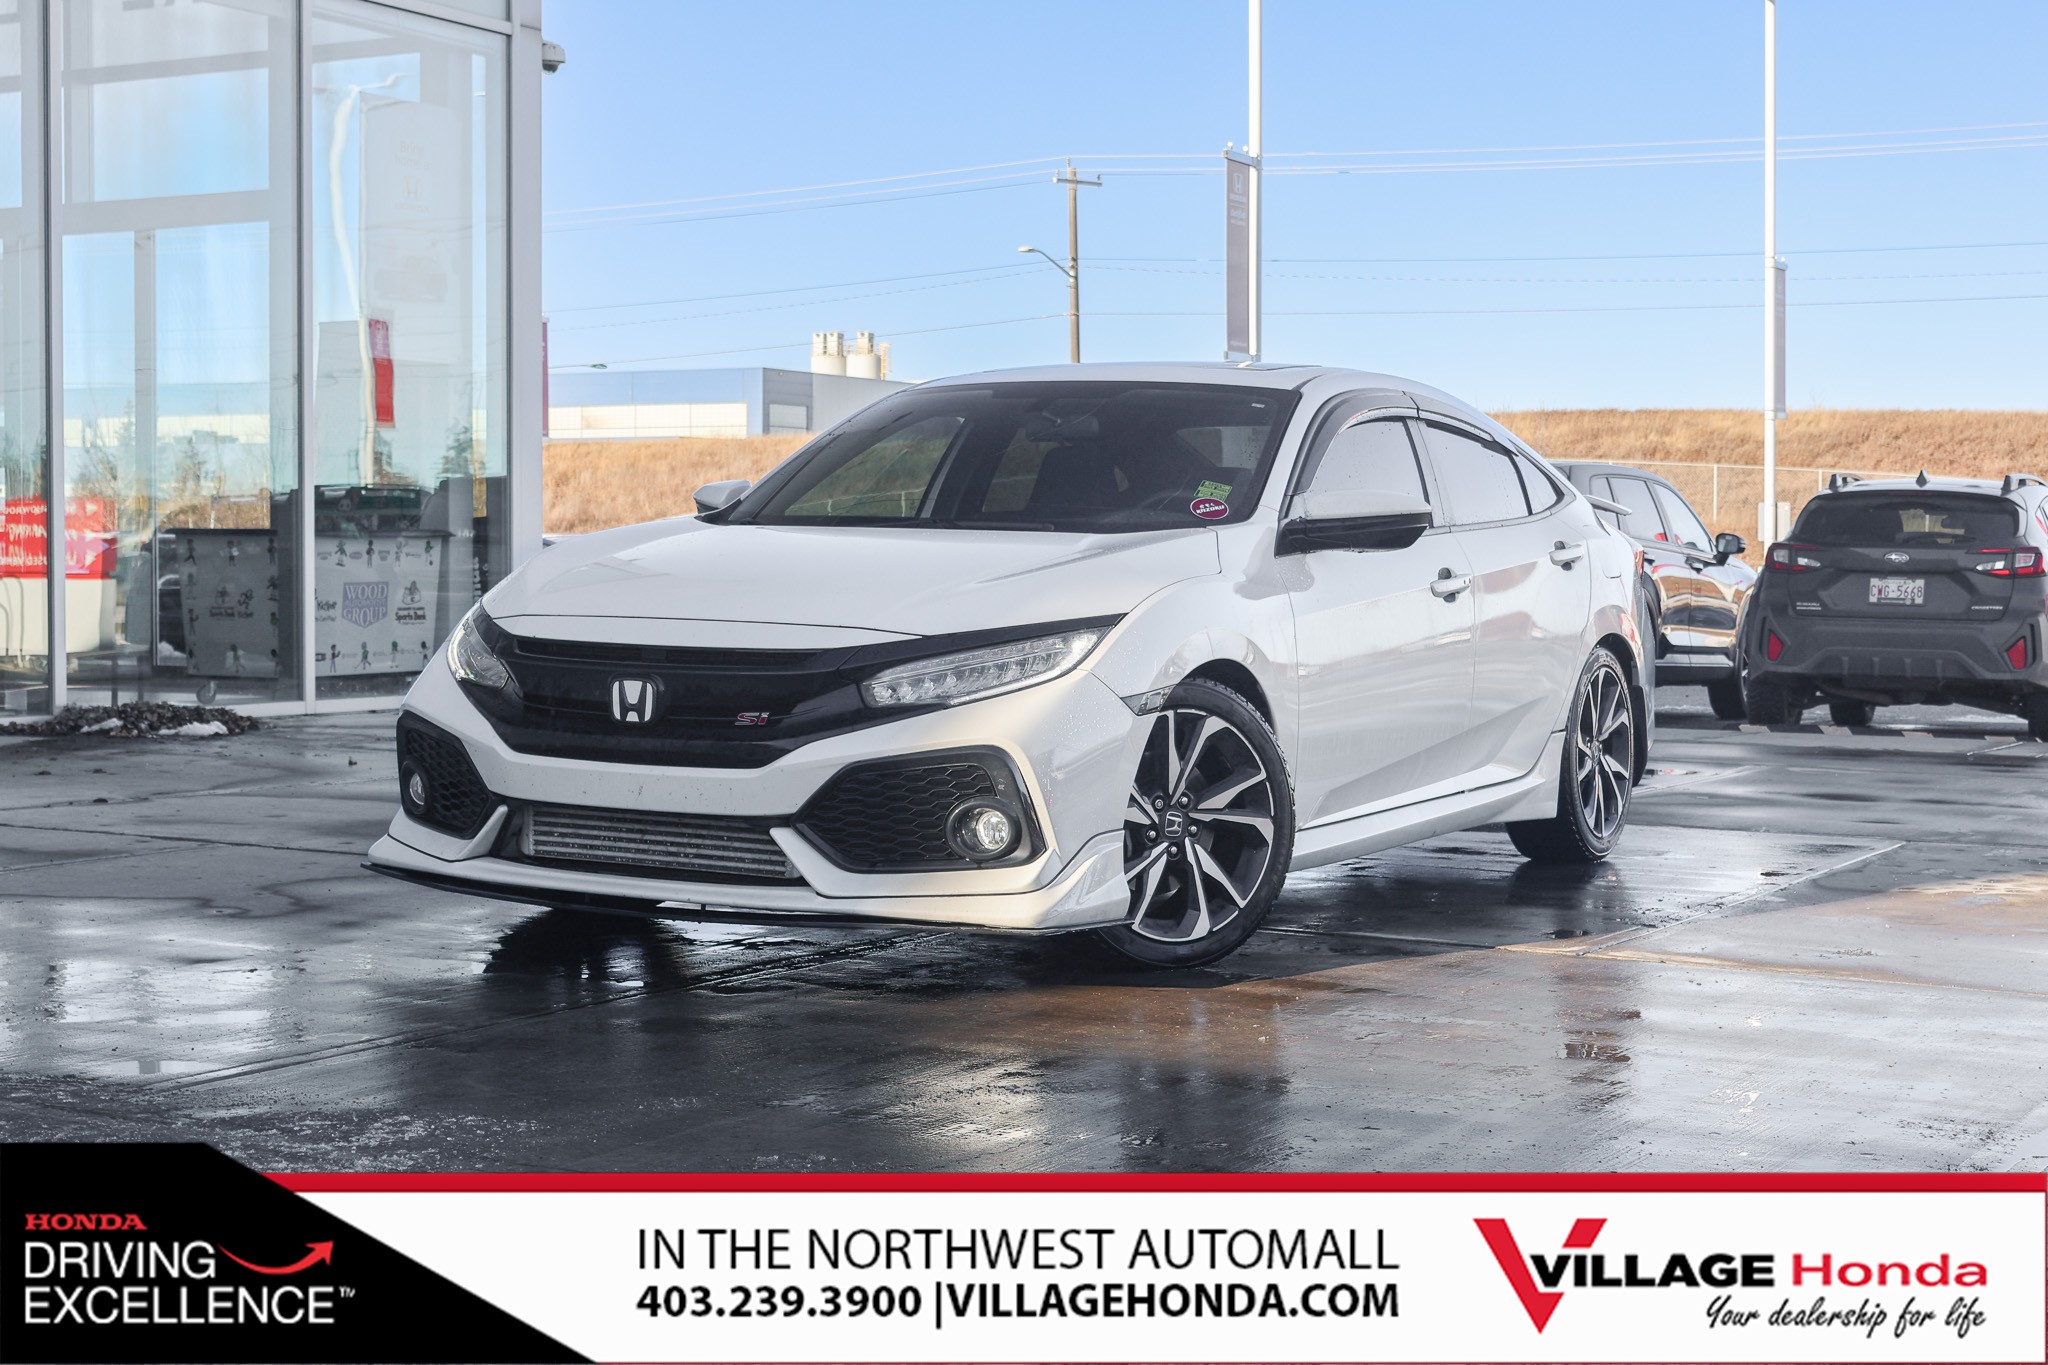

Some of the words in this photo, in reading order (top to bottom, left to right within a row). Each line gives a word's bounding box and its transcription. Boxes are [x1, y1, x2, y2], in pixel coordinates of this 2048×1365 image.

[344, 584, 388, 600] WOOD
[343, 607, 386, 627] GROUP
[735, 712, 770, 726] Si
